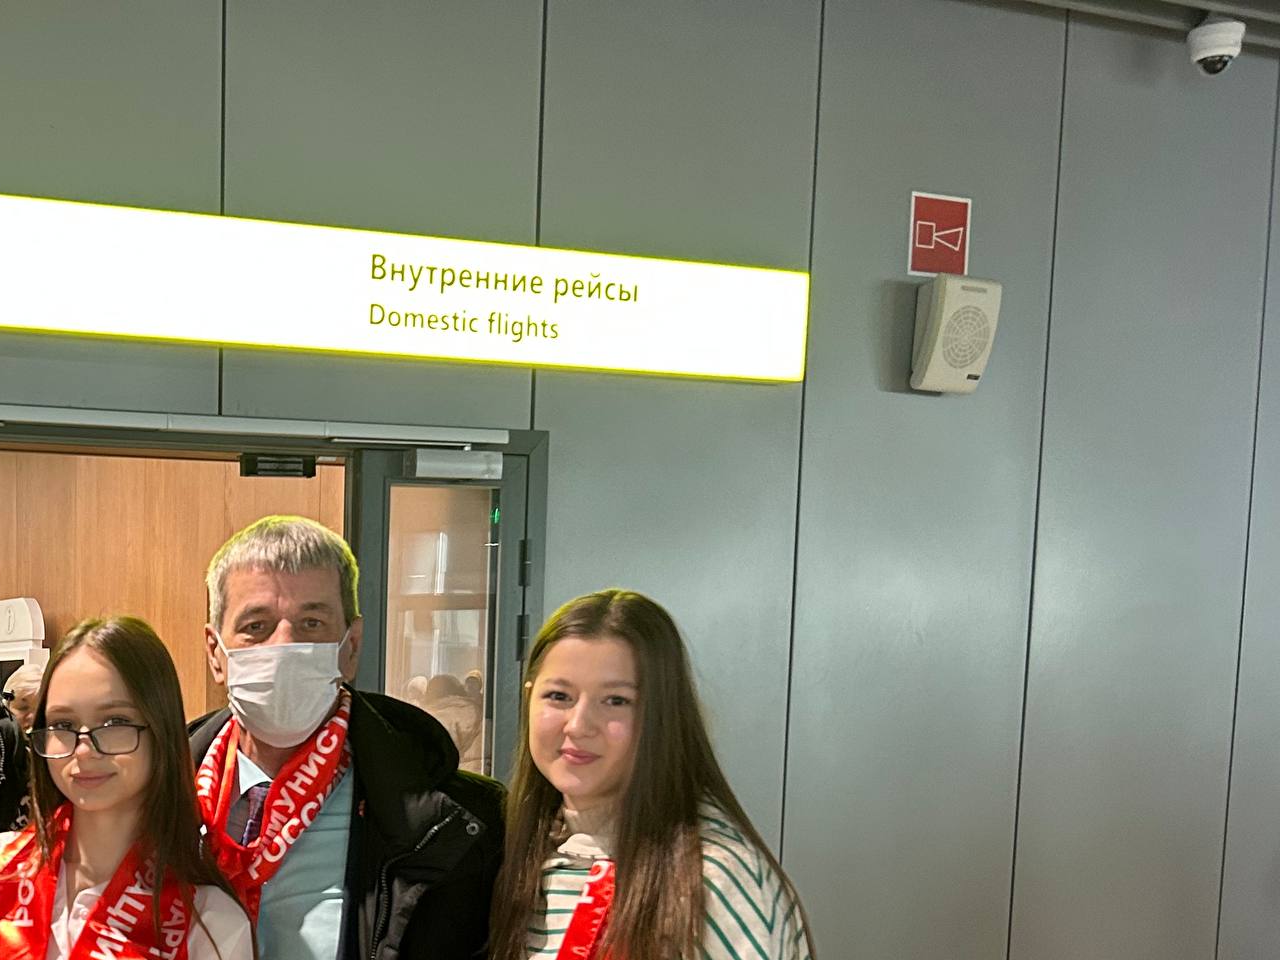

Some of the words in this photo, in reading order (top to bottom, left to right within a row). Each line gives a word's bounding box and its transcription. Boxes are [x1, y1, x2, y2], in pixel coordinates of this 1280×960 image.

[371, 254, 543, 294] Внутренние
[554, 273, 638, 303] рейсы
[370, 304, 478, 333] Domestic
[488, 311, 559, 342] flights
